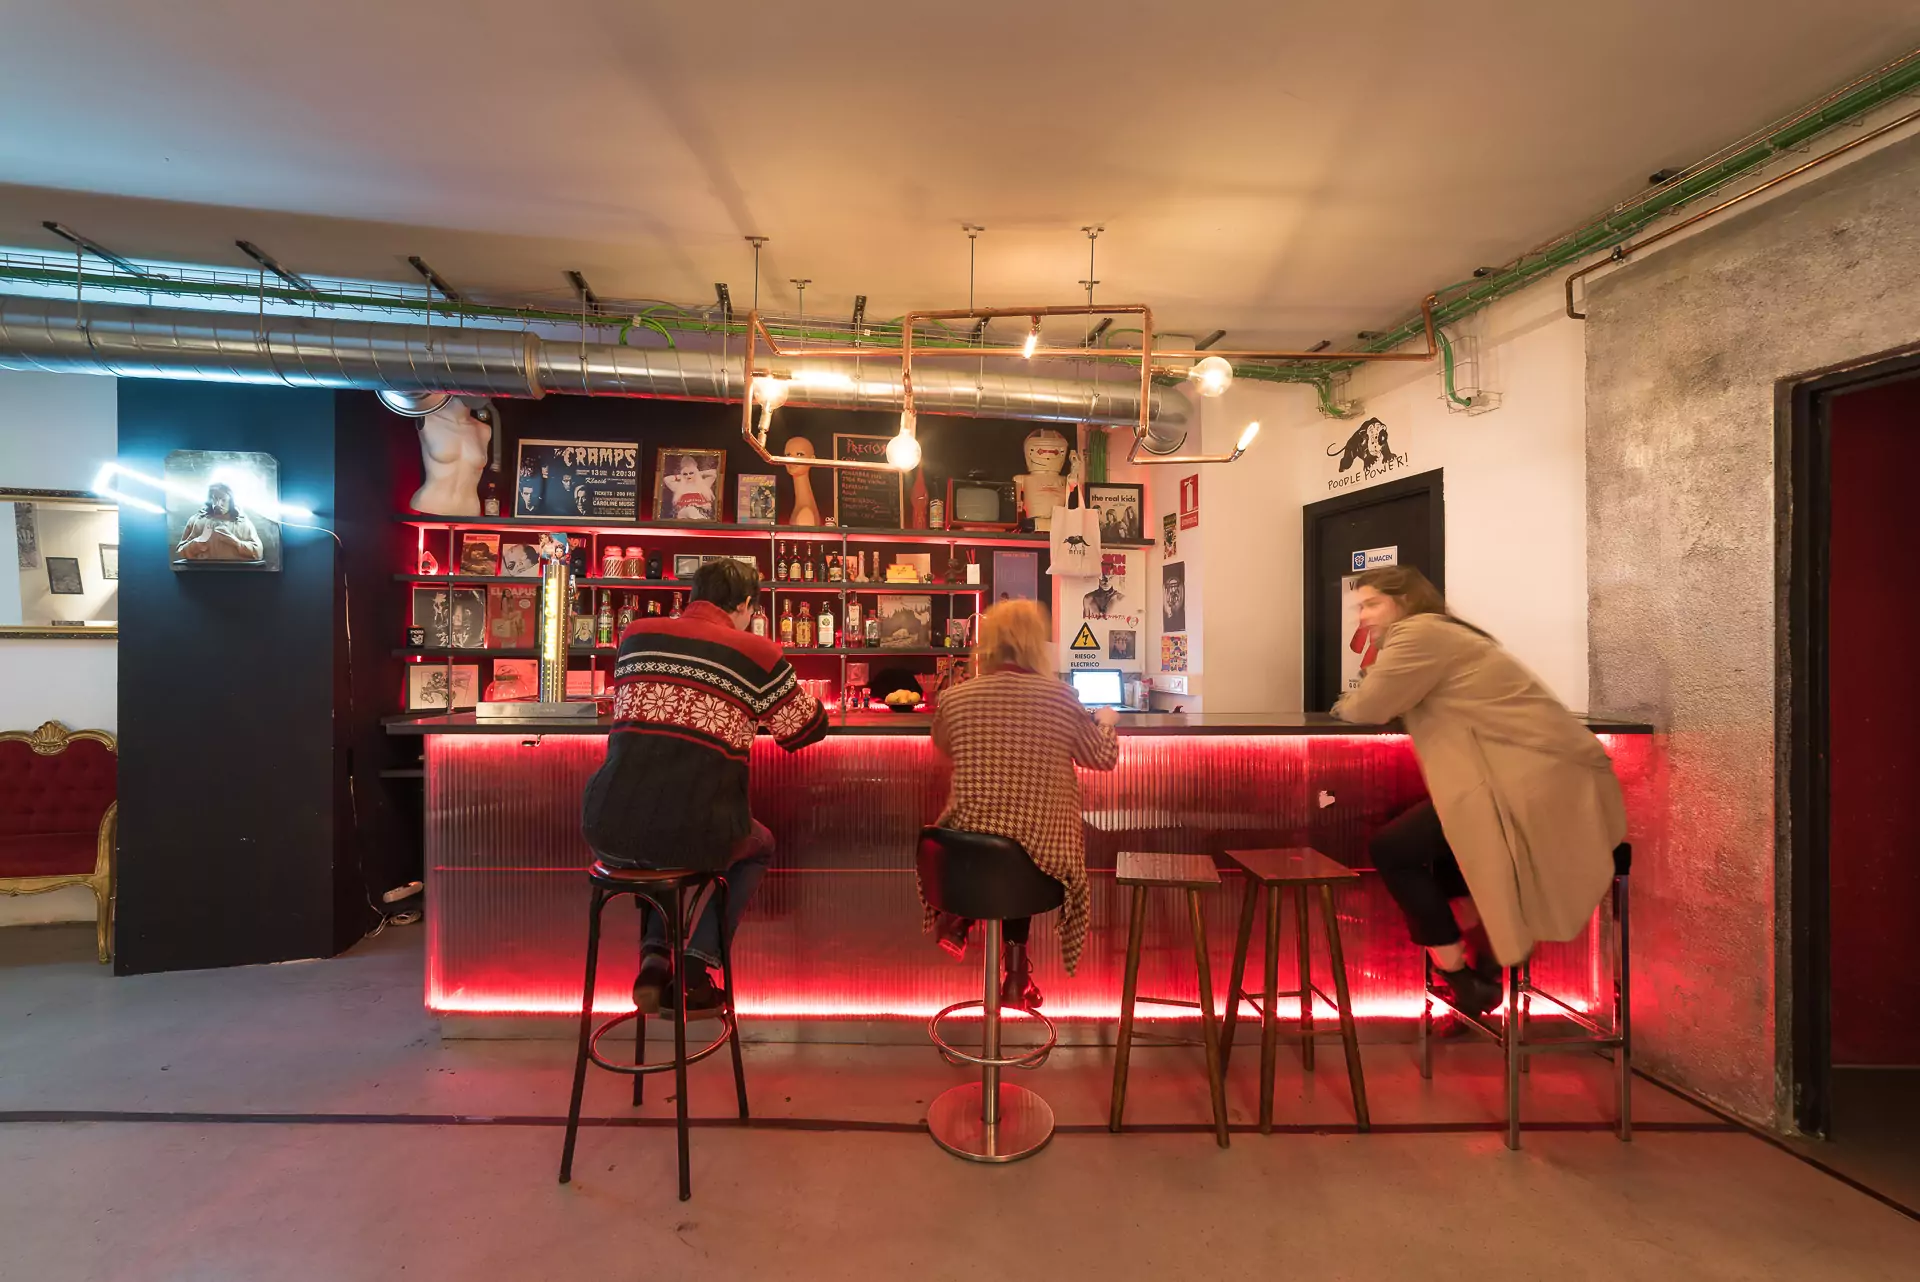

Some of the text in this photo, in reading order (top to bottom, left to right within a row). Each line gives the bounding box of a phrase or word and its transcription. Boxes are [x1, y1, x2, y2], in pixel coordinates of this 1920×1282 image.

[563, 446, 637, 469] CRAMPS
[1328, 452, 1409, 491] POODLE POWER!
[1091, 494, 1104, 502] the
[1120, 495, 1136, 503] kids
[490, 587, 502, 596] EL
